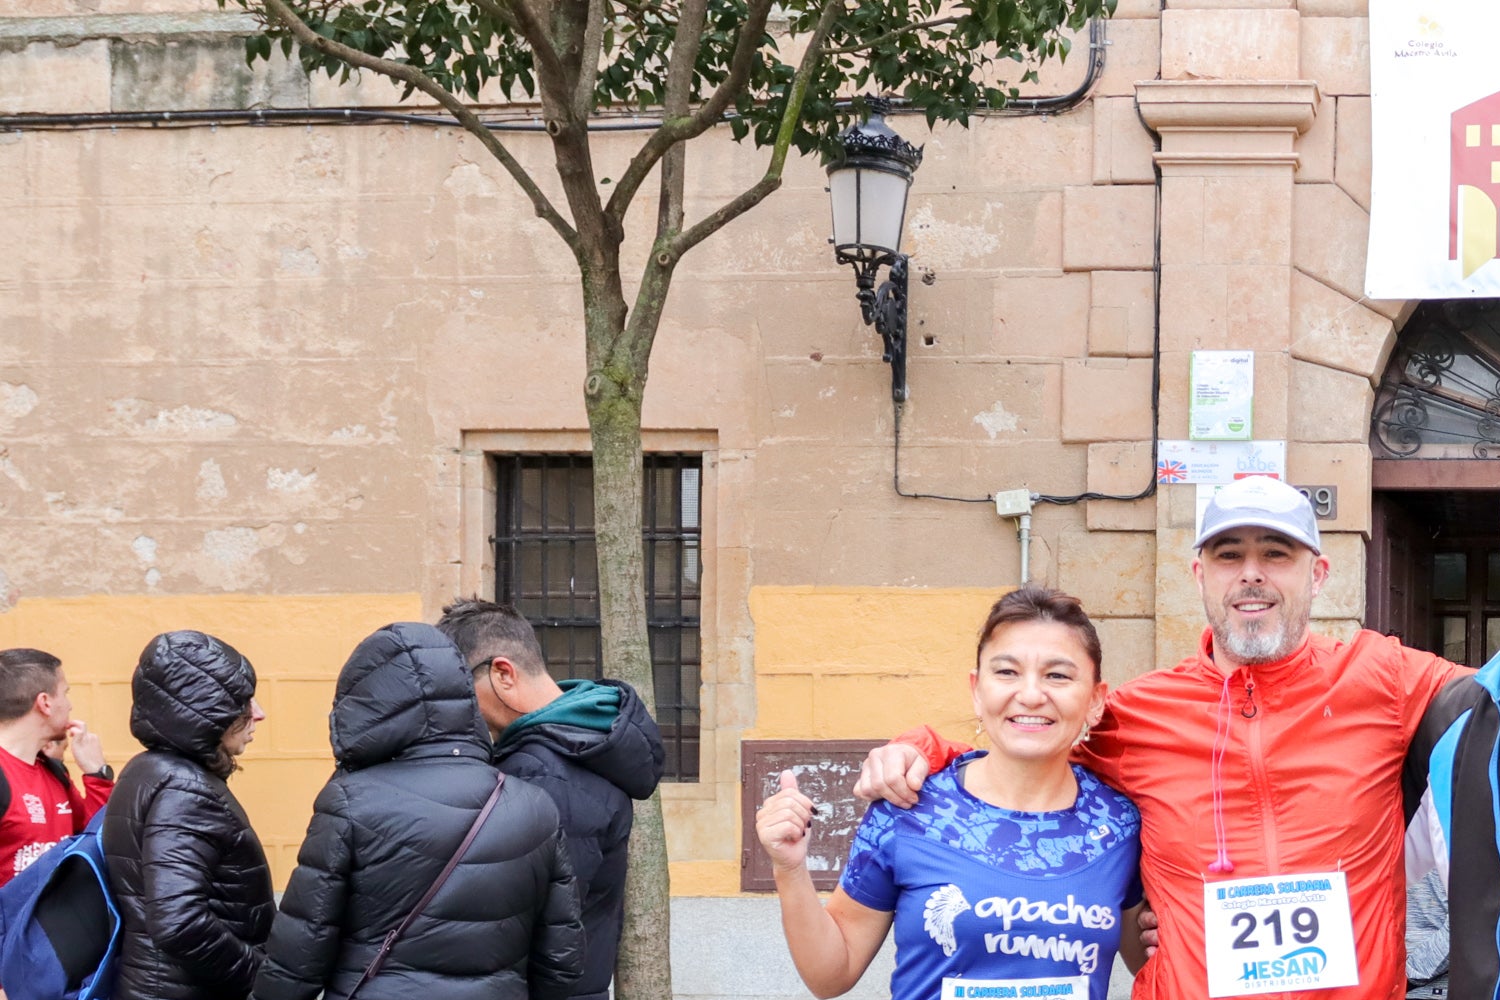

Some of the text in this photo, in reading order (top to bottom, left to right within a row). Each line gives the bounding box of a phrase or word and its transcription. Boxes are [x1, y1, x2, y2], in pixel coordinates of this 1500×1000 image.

[1227, 883, 1275, 899] CARRERA
[1277, 879, 1332, 896] SOLIDARIA
[975, 894, 1116, 930] apaches
[1221, 899, 1257, 910] Colegio
[1257, 896, 1299, 907] Maestro
[1231, 907, 1320, 950] 219
[984, 933, 1099, 974] running
[1240, 956, 1320, 981] HESAN
[967, 985, 1018, 999] CARRERA
[1020, 983, 1073, 998] SOLIDARIA
[1244, 976, 1320, 989] DISTRIBUCIÓN
